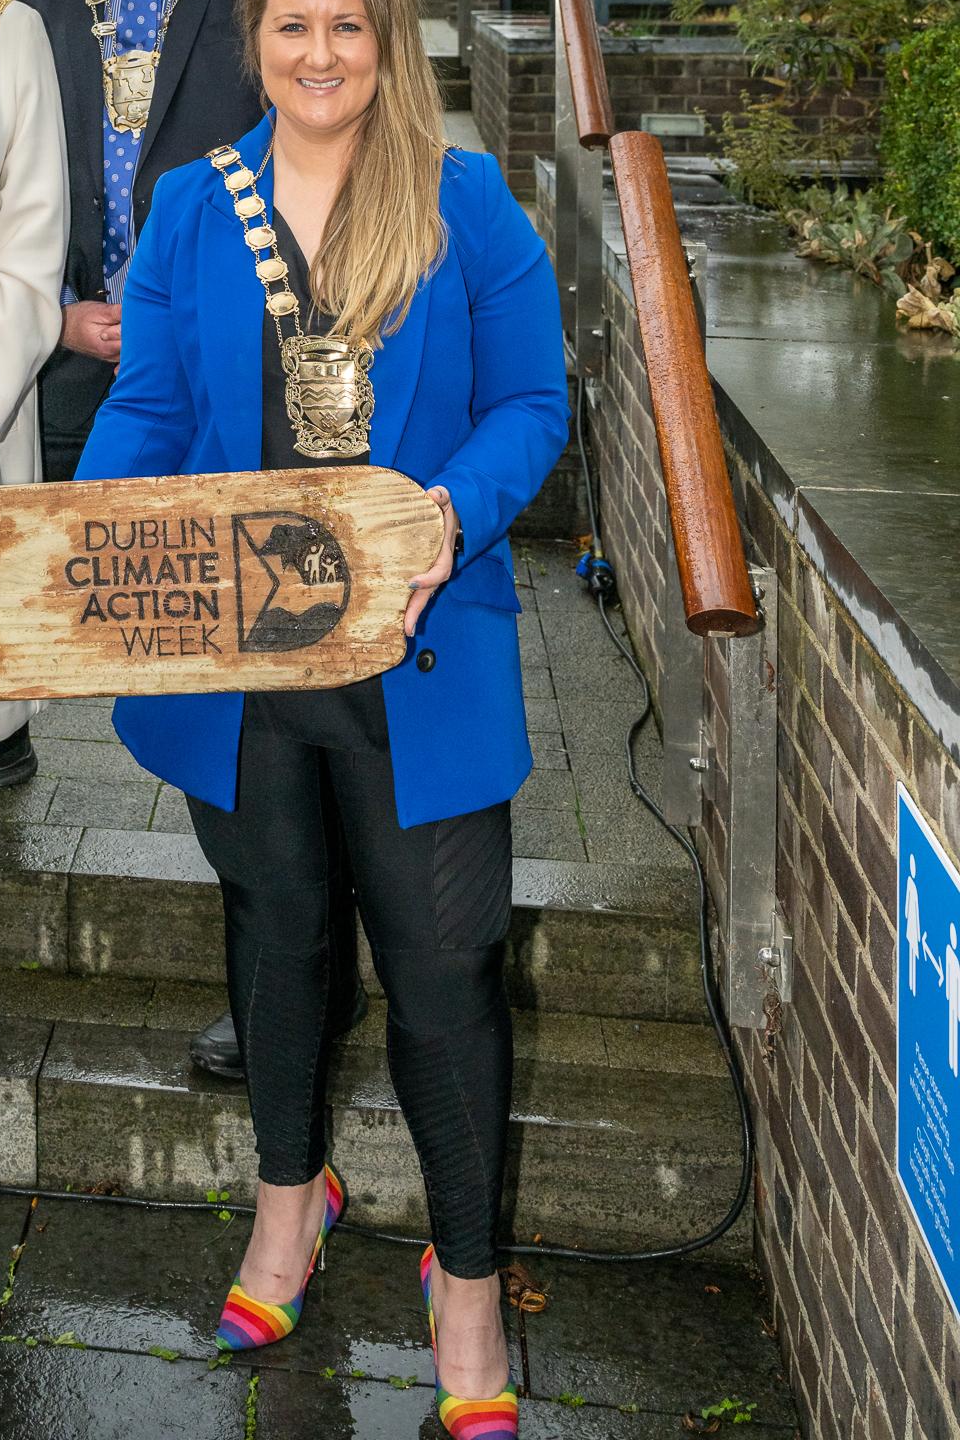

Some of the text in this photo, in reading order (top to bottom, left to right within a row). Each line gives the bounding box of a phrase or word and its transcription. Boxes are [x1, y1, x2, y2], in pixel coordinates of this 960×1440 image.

[84, 517, 216, 552] DUBLIN
[64, 552, 220, 587] CLIMATE
[80, 589, 220, 624] ACTION
[120, 624, 223, 657] WEEK
